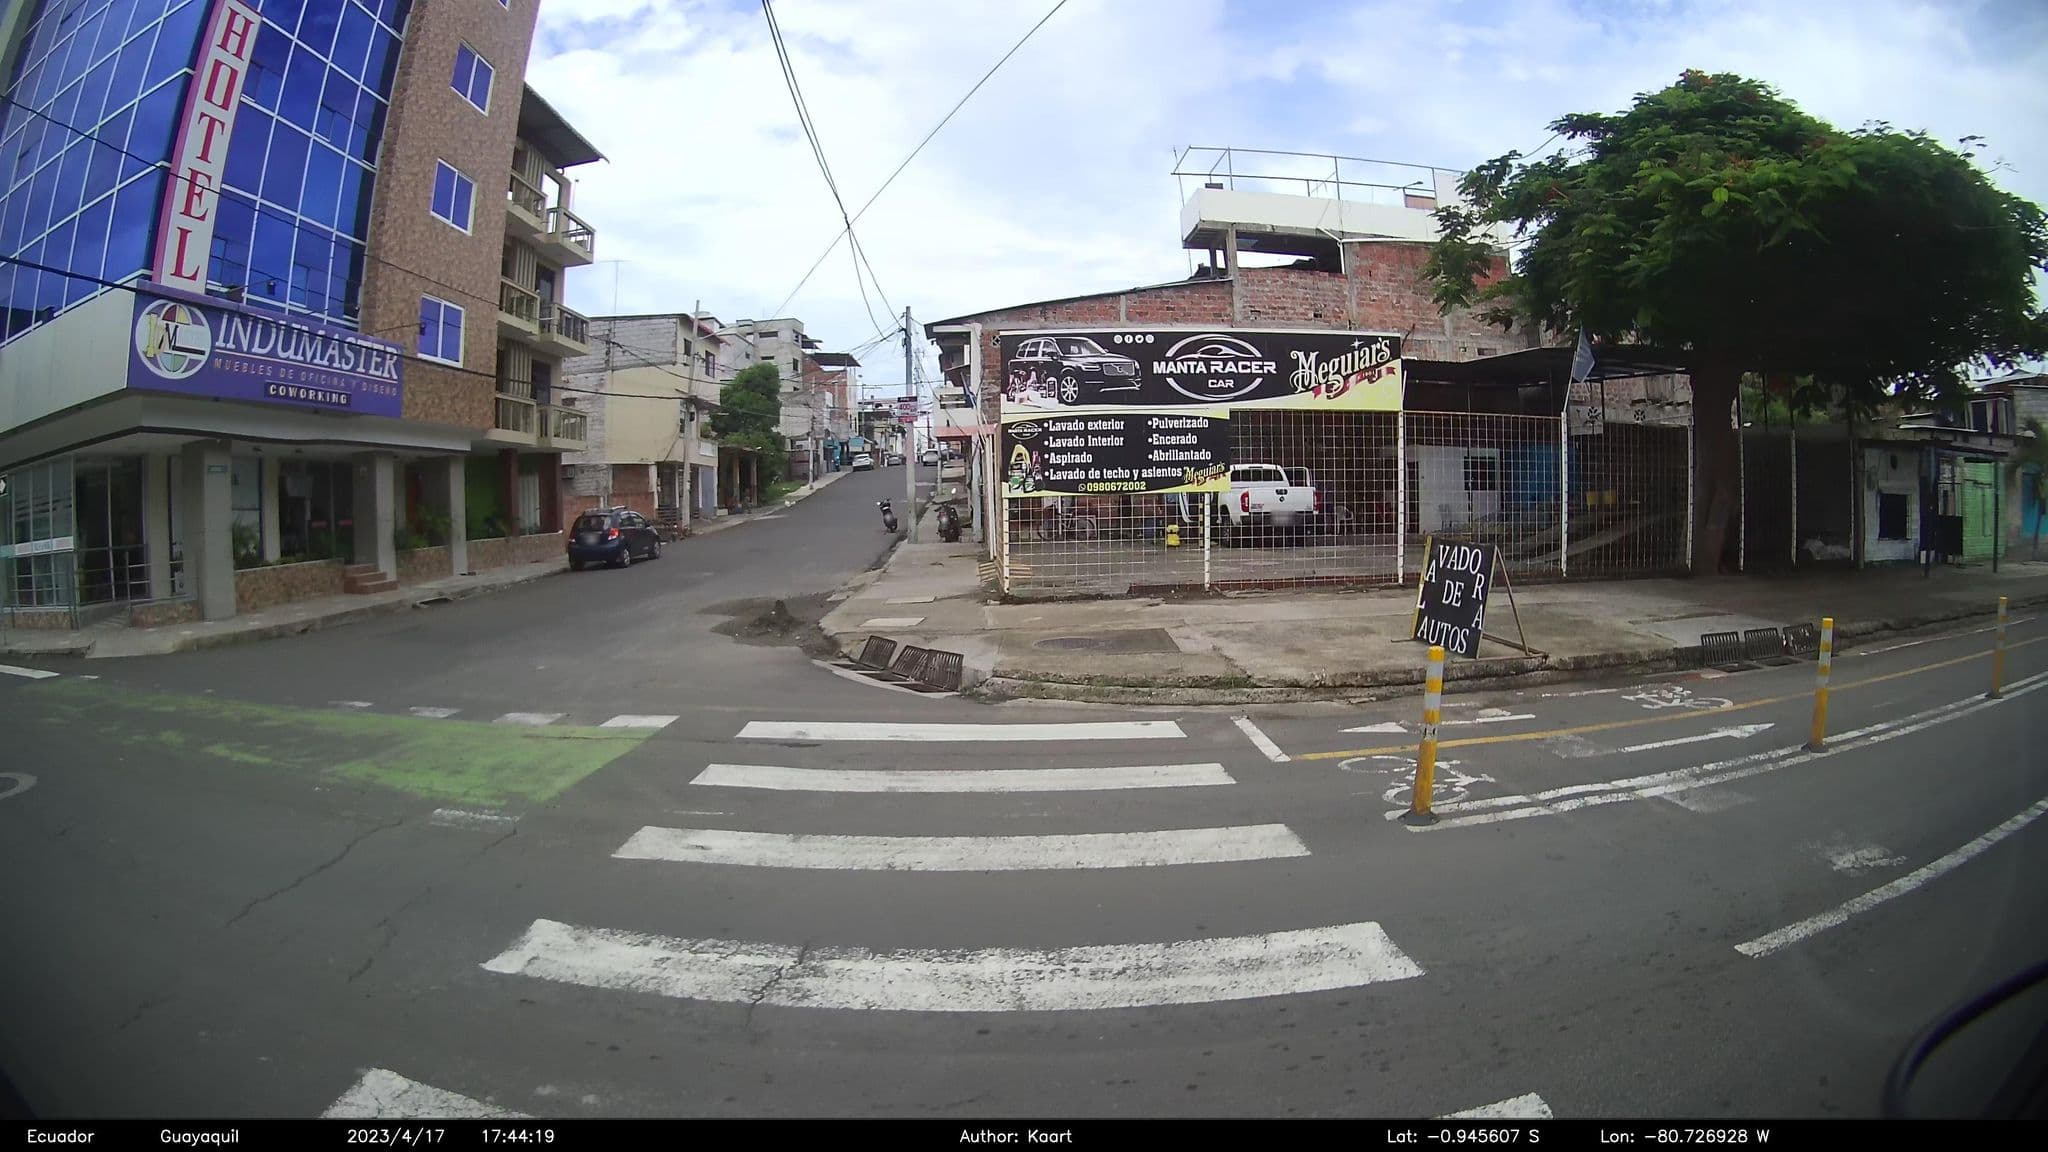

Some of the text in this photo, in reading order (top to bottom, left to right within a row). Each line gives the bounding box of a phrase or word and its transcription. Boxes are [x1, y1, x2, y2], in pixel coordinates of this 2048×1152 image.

[170, 6, 255, 282] HOTEL
[215, 311, 398, 380] INDUMASTER
[214, 358, 273, 376] MUEBLES
[279, 368, 295, 380] DE
[1152, 361, 1277, 375] MANTA RACER
[1289, 337, 1391, 399] Meguiar's
[1208, 378, 1235, 389] CAR
[269, 384, 348, 405] COWORKING
[1049, 418, 1125, 432] Lavado exterior
[1152, 417, 1209, 430] Pulverizado
[1049, 435, 1085, 448] Lavado
[1152, 432, 1198, 446] Encerado
[1049, 451, 1093, 466] Aspirado
[1152, 448, 1212, 462] Abrillantado
[1049, 466, 1182, 481] Lavado de techo y asientos
[1087, 481, 1146, 492] 0980672002
[1441, 579, 1465, 608] DE
[1417, 615, 1470, 654] AUTOS
